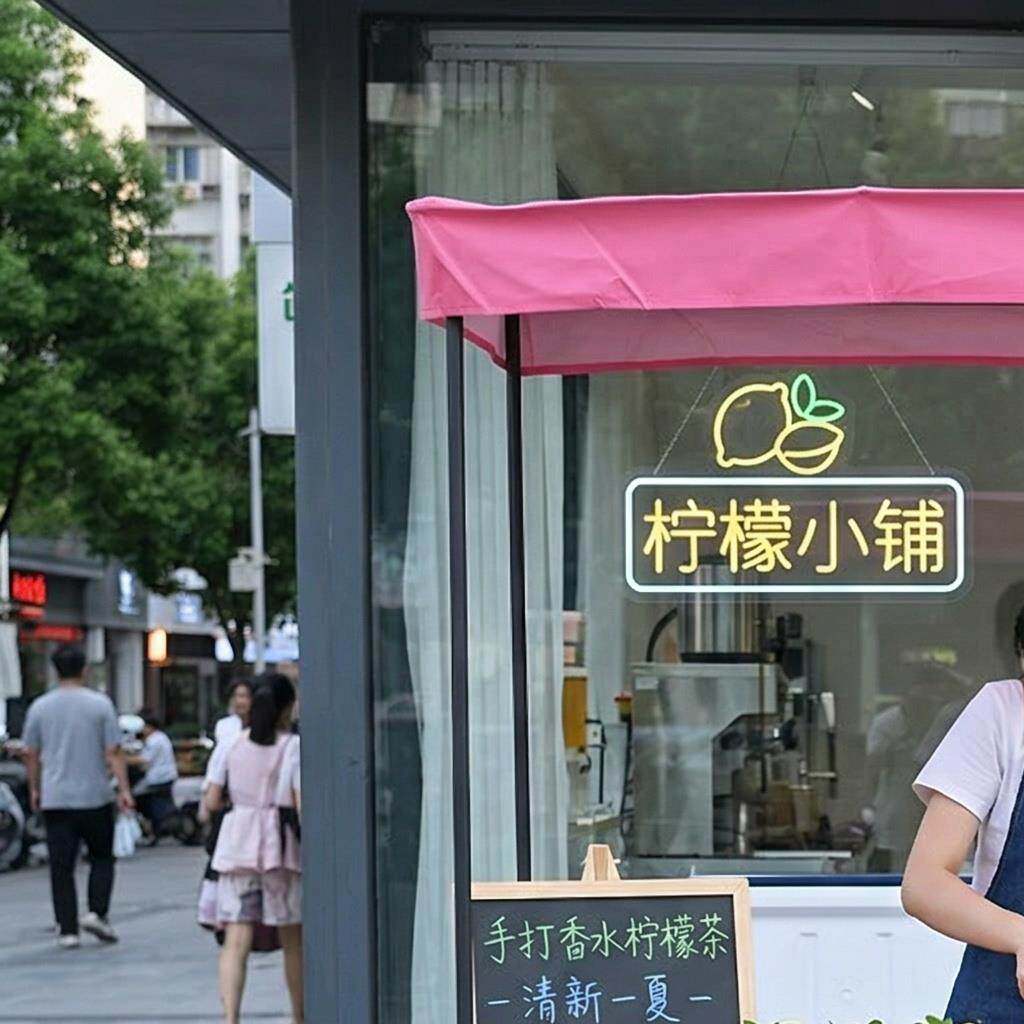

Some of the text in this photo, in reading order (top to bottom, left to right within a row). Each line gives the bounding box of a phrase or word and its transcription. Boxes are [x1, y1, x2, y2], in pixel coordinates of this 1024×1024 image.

[642, 498, 945, 574] 柠檬小铺
[483, 912, 730, 965] 手打香水柠檬茶
